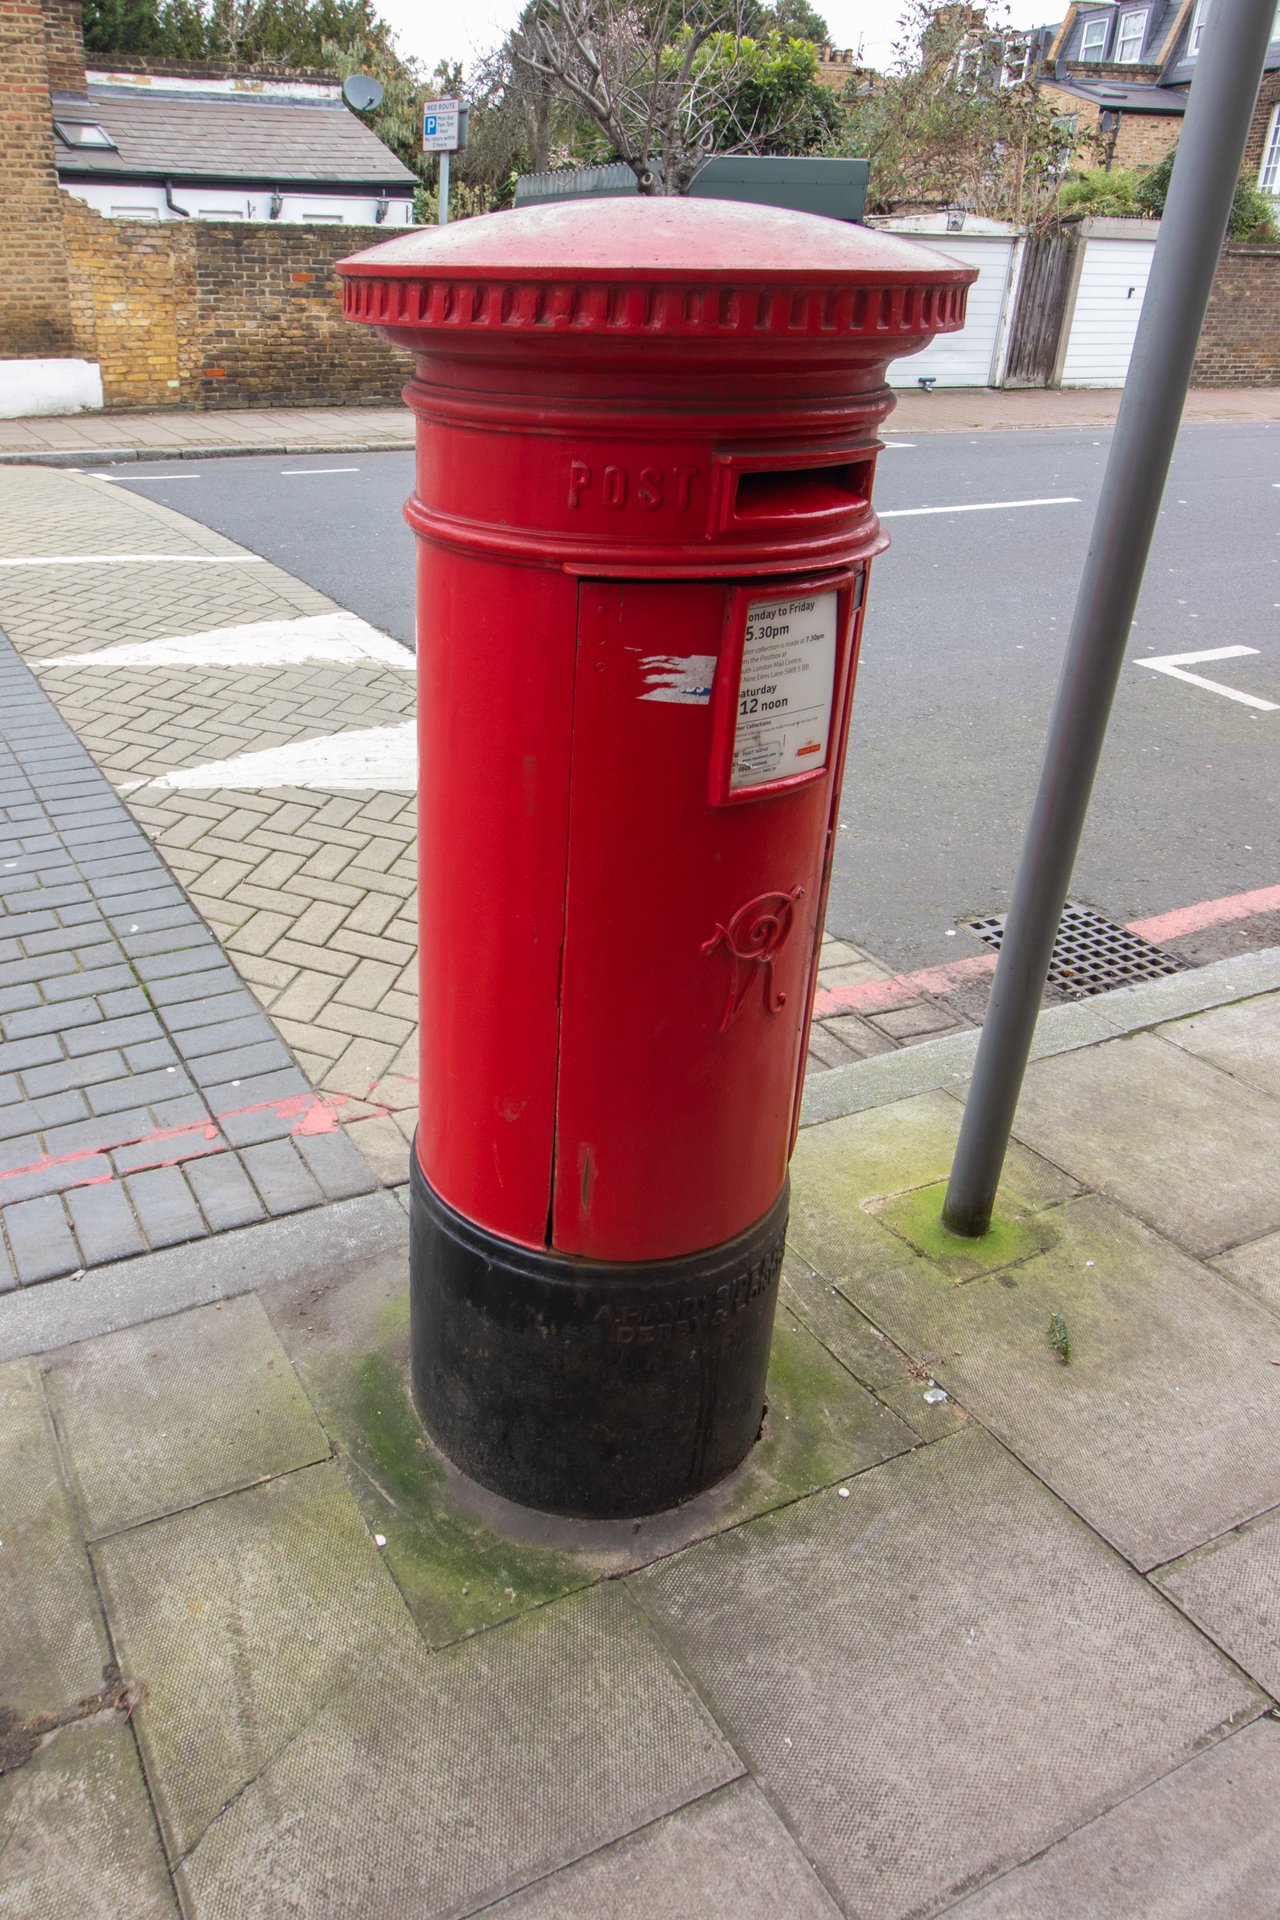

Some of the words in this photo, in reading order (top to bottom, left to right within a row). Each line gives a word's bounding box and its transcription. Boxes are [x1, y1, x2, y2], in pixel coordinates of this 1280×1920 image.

[438, 102, 456, 110] ROUTE
[568, 460, 700, 511] POST
[748, 610, 777, 622] onday
[778, 607, 788, 617] to
[789, 601, 816, 615] Friday
[745, 625, 790, 642] 5.30pm
[755, 644, 780, 654] collection
[806, 633, 825, 643] 7.30pm
[760, 653, 781, 662] Postbox
[752, 663, 773, 672] London
[773, 659, 785, 668] Mail
[757, 672, 770, 681] Elms
[771, 670, 784, 678] Lane
[740, 685, 777, 698] aturday
[740, 698, 759, 716] 12
[761, 698, 788, 711] noon
[746, 720, 772, 730] Collections
